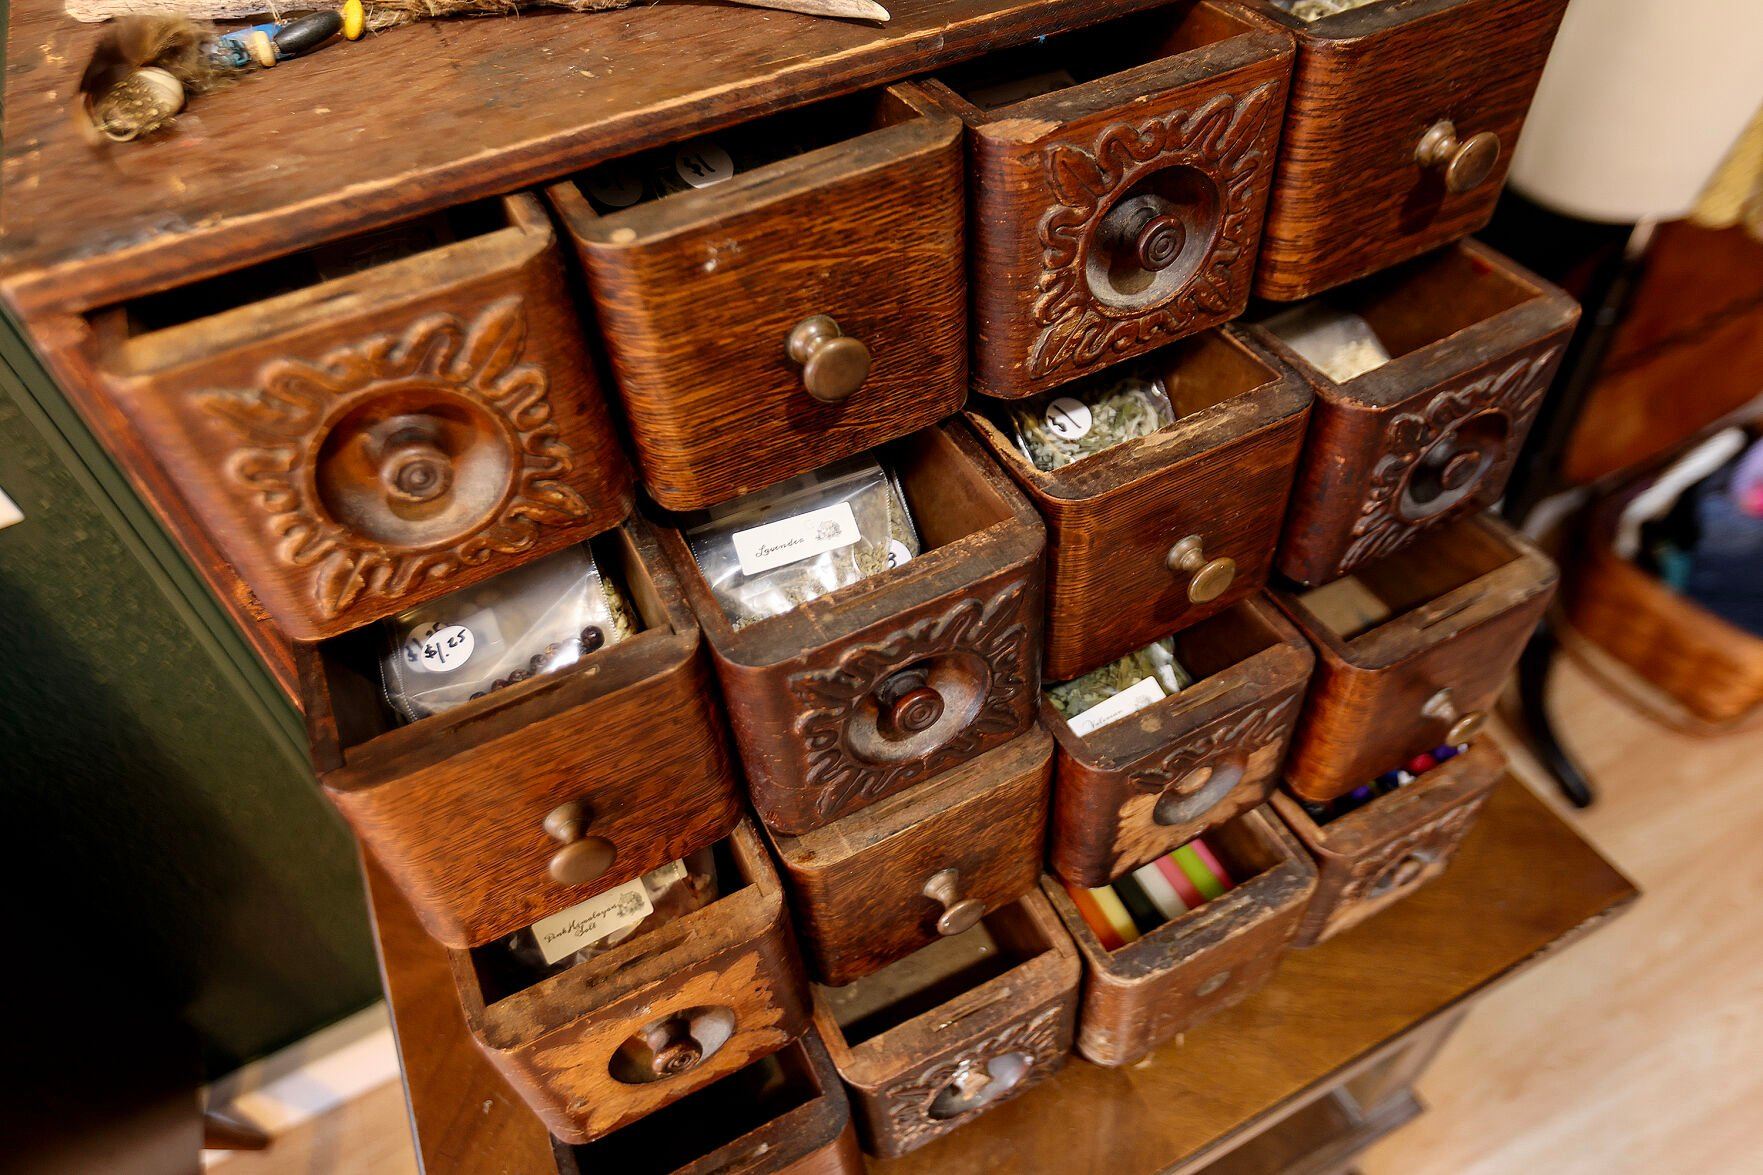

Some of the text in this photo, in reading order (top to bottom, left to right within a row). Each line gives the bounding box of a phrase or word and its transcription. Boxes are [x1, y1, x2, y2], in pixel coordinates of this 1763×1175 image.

[755, 535, 805, 558] Lavender
[424, 628, 466, 664] $1.25
[543, 928, 568, 943] Pink
